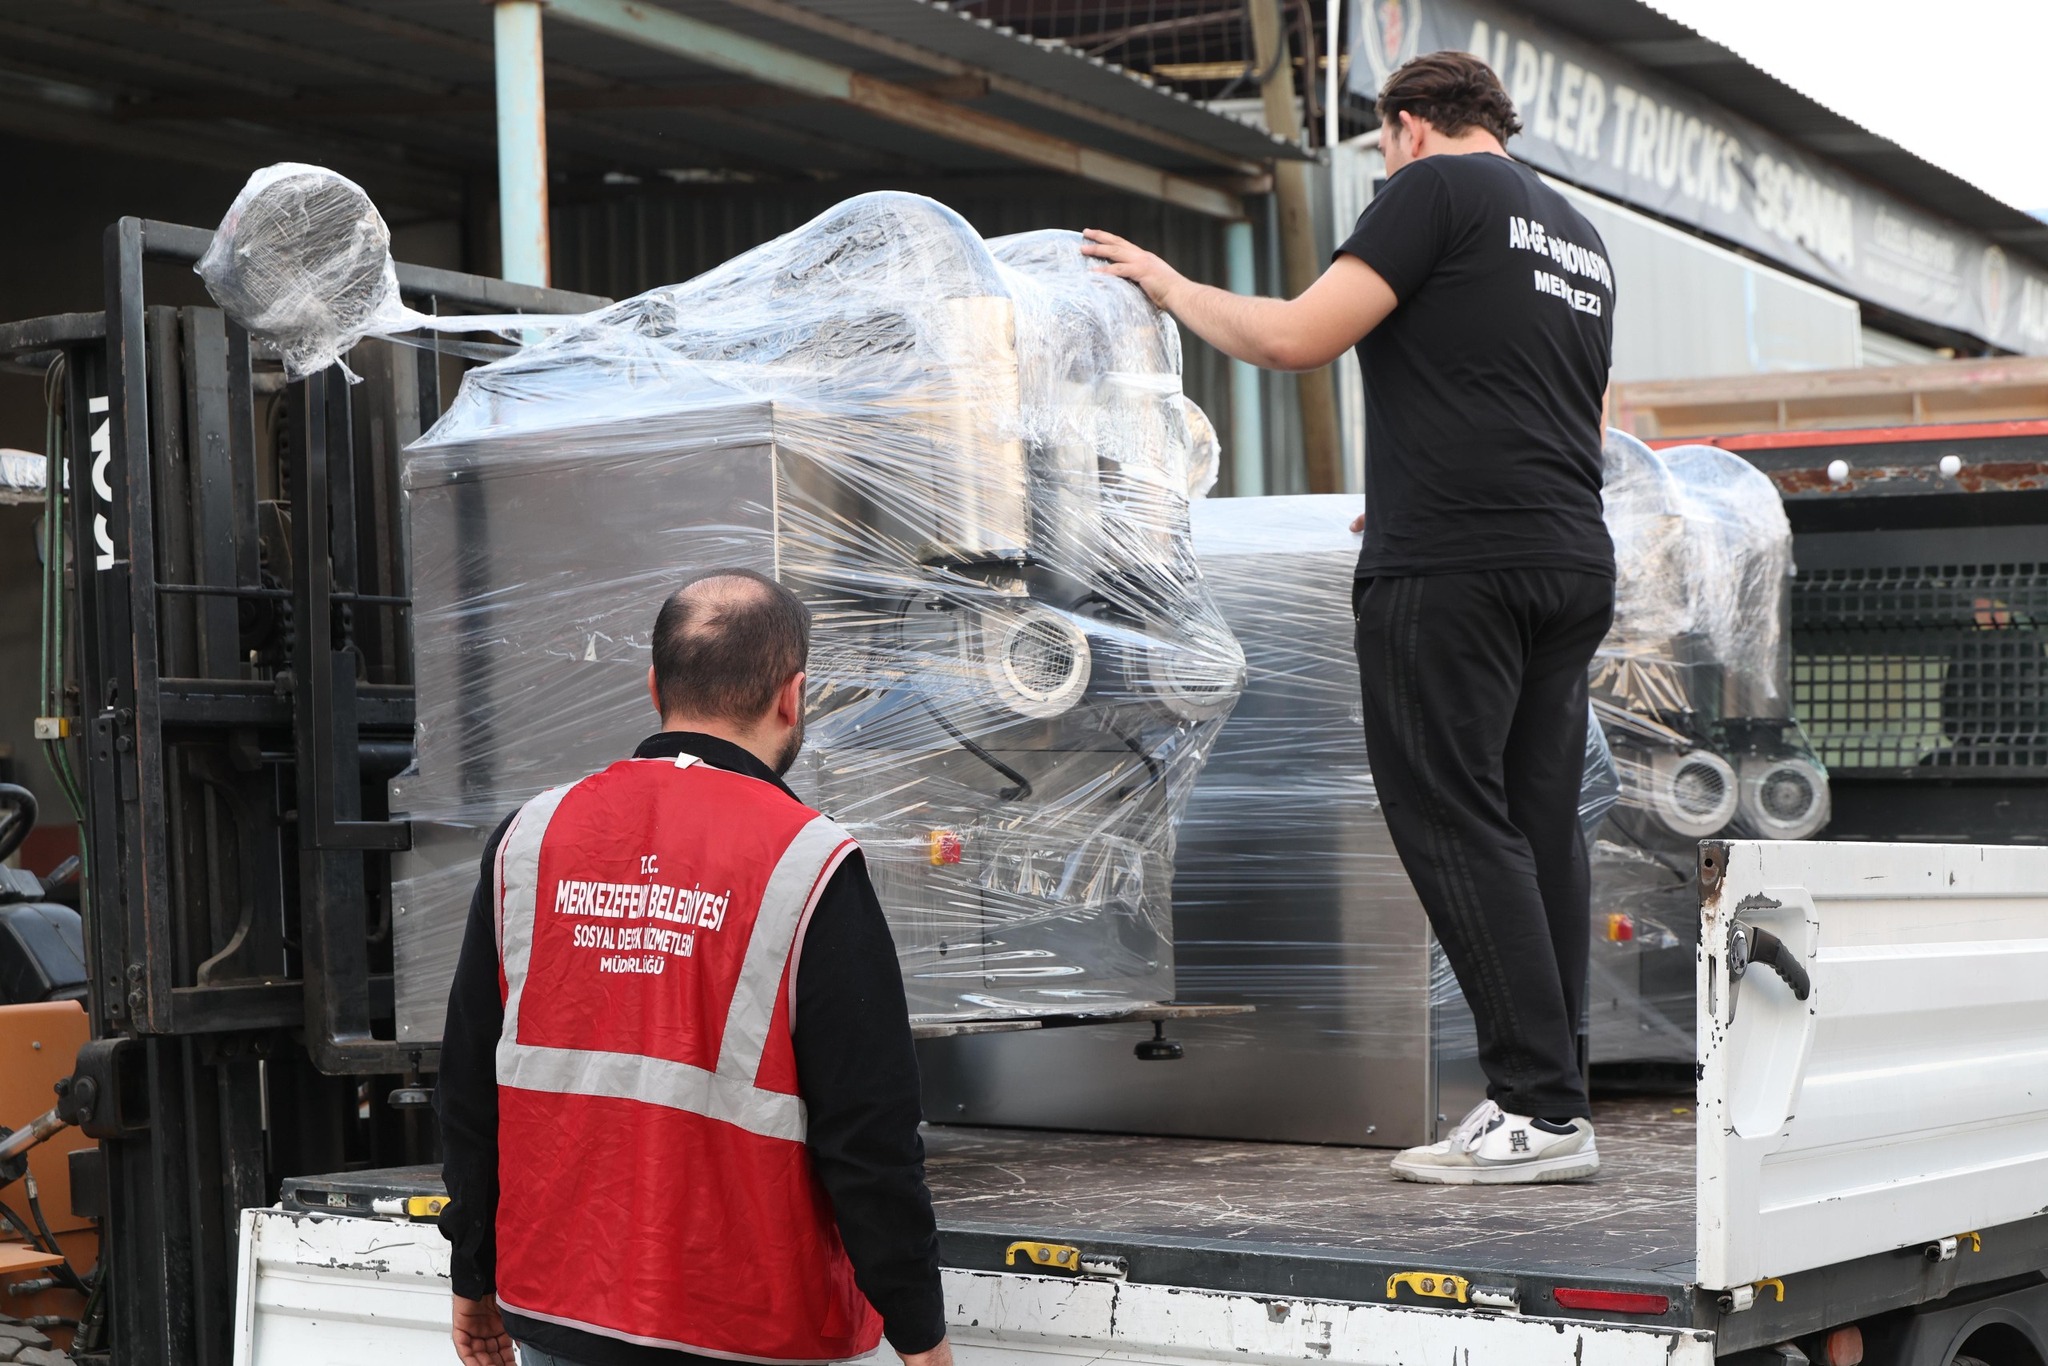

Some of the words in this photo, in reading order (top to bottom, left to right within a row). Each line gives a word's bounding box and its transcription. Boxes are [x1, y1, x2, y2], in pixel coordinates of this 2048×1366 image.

[1611, 84, 1743, 213] TRUCKS
[1509, 215, 1549, 257] AR-GE
[1533, 269, 1602, 317] MERKEZİ
[640, 854, 659, 875] T.C.
[554, 875, 653, 919] MERKEZEFENİ
[647, 882, 731, 932] BELEDİYESİ
[573, 923, 616, 950] SOSYAL
[599, 954, 666, 976] MÜDRLÜĞÜ
